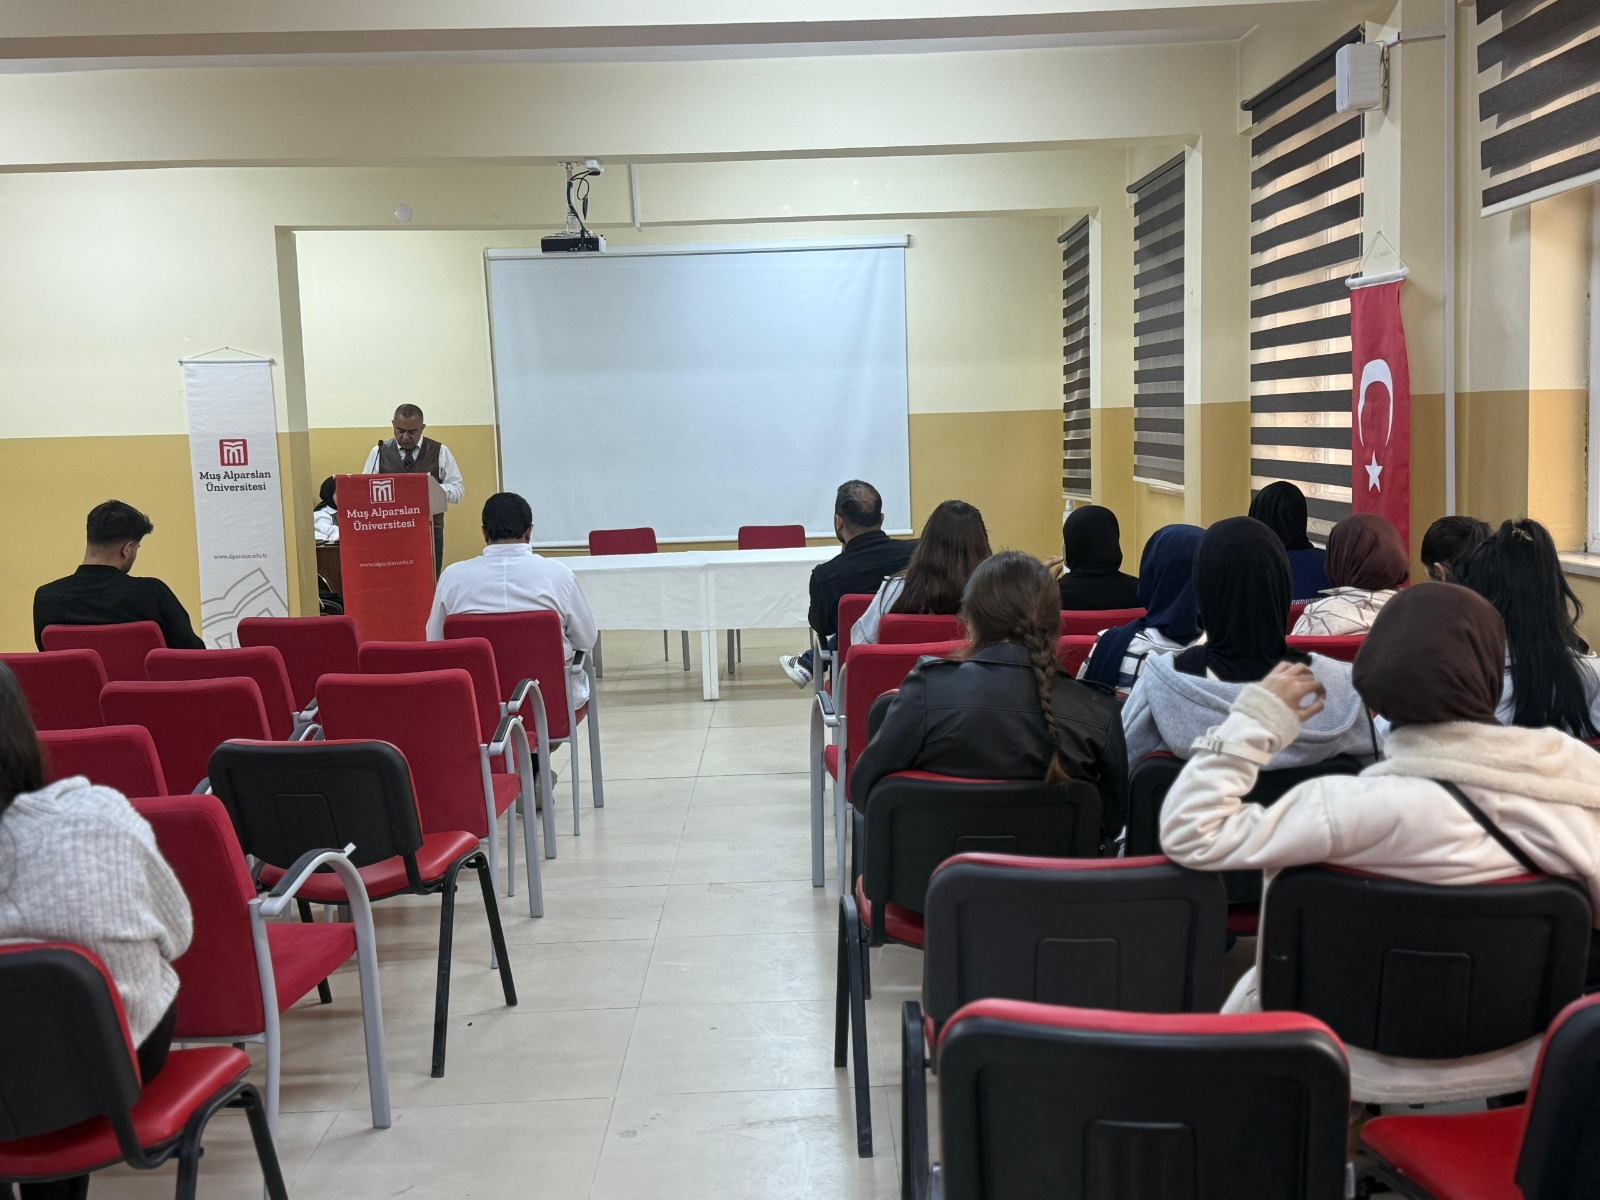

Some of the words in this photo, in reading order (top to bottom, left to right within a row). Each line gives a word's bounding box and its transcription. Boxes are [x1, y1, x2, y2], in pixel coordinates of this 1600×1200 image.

[199, 471, 221, 482] Muş
[223, 470, 271, 482] Alparslan
[205, 481, 267, 492] Üniversitesi
[346, 509, 369, 520] Muş
[371, 505, 421, 519] Alparslan
[353, 518, 416, 531] Üniversitesi
